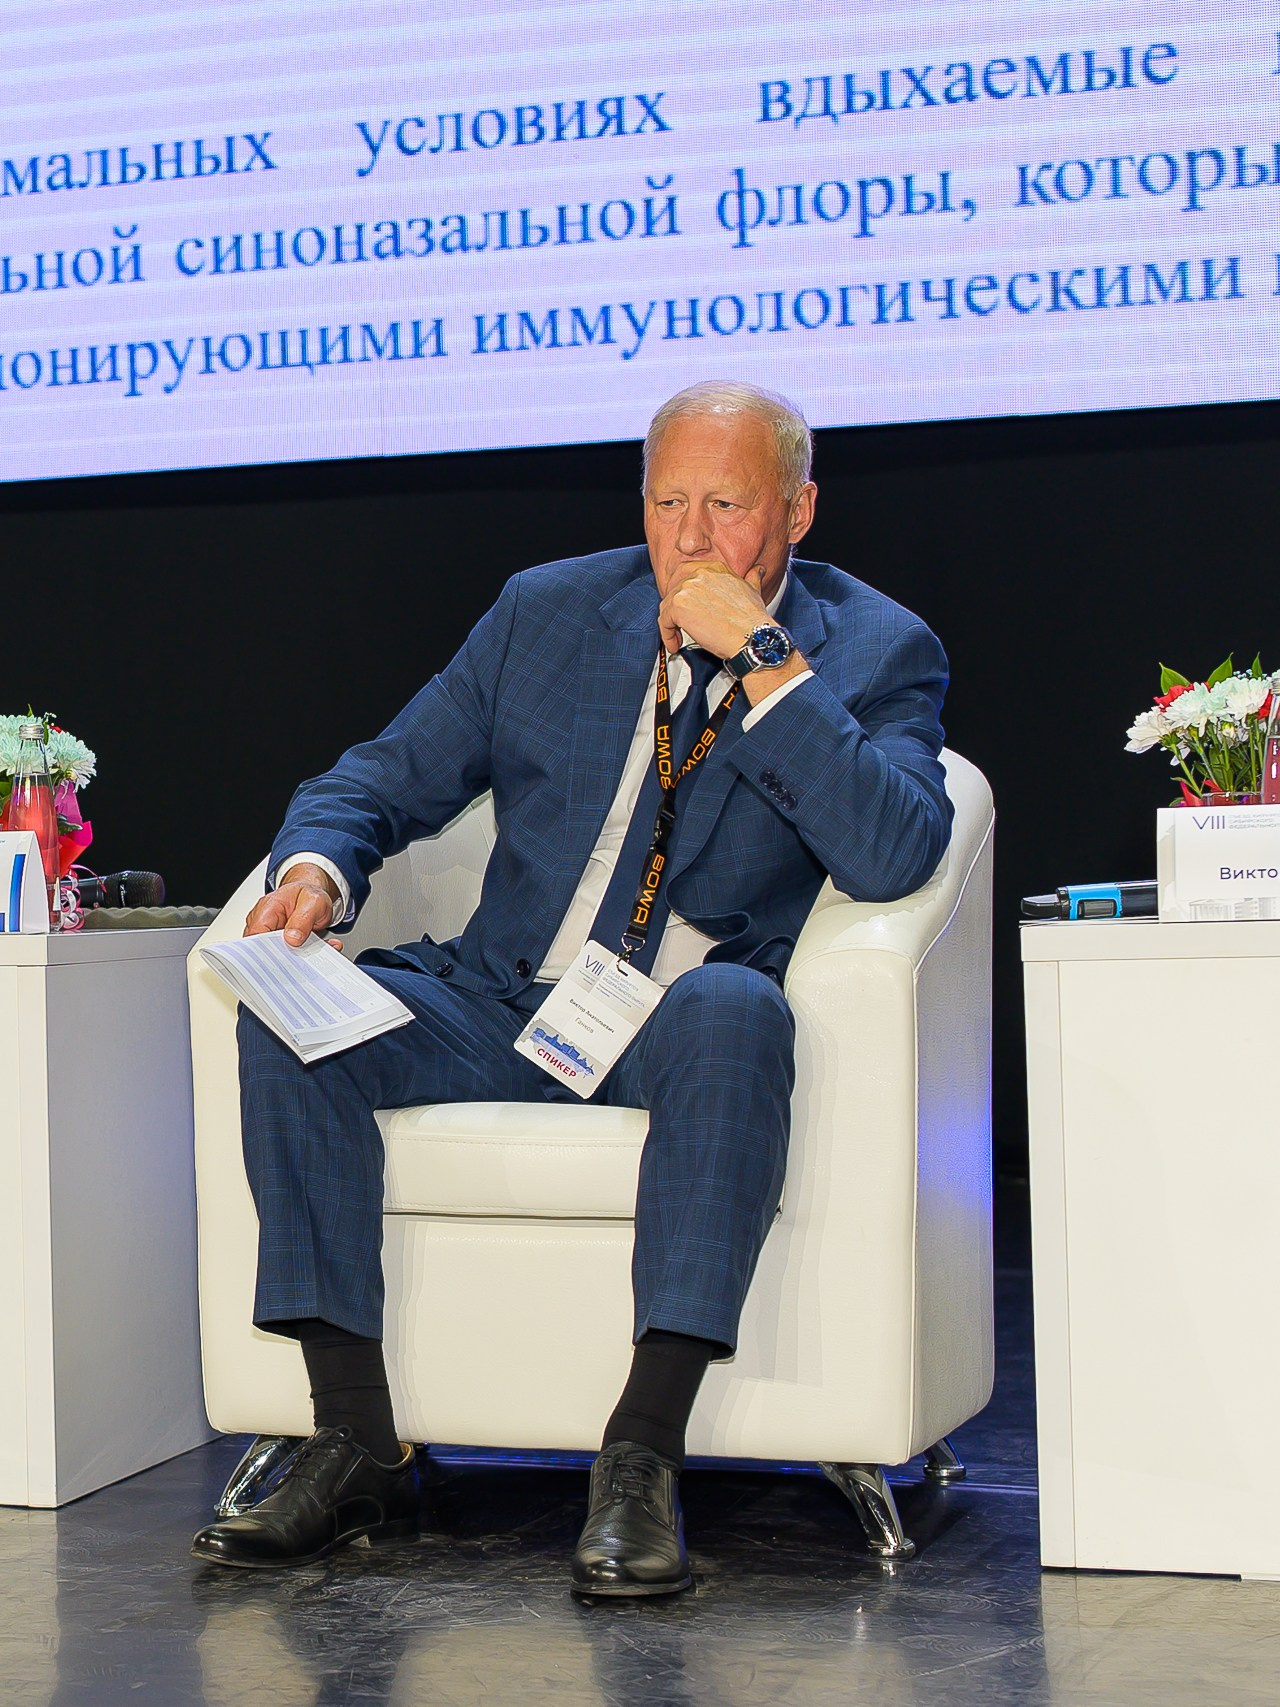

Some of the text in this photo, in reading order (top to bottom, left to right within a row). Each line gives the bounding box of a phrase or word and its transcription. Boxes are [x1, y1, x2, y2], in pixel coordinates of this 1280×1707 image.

[355, 92, 672, 177] условиях
[756, 41, 1179, 128] вдыхаемые
[175, 175, 682, 275] синоназальной
[716, 168, 978, 249] флоры,
[470, 253, 1245, 360] иммунологическими
[657, 725, 671, 790] BOWA
[1192, 815, 1226, 830] VIII
[633, 854, 665, 924] BOWA
[584, 954, 606, 977] VIII
[536, 1048, 577, 1078] СПИКЕР
